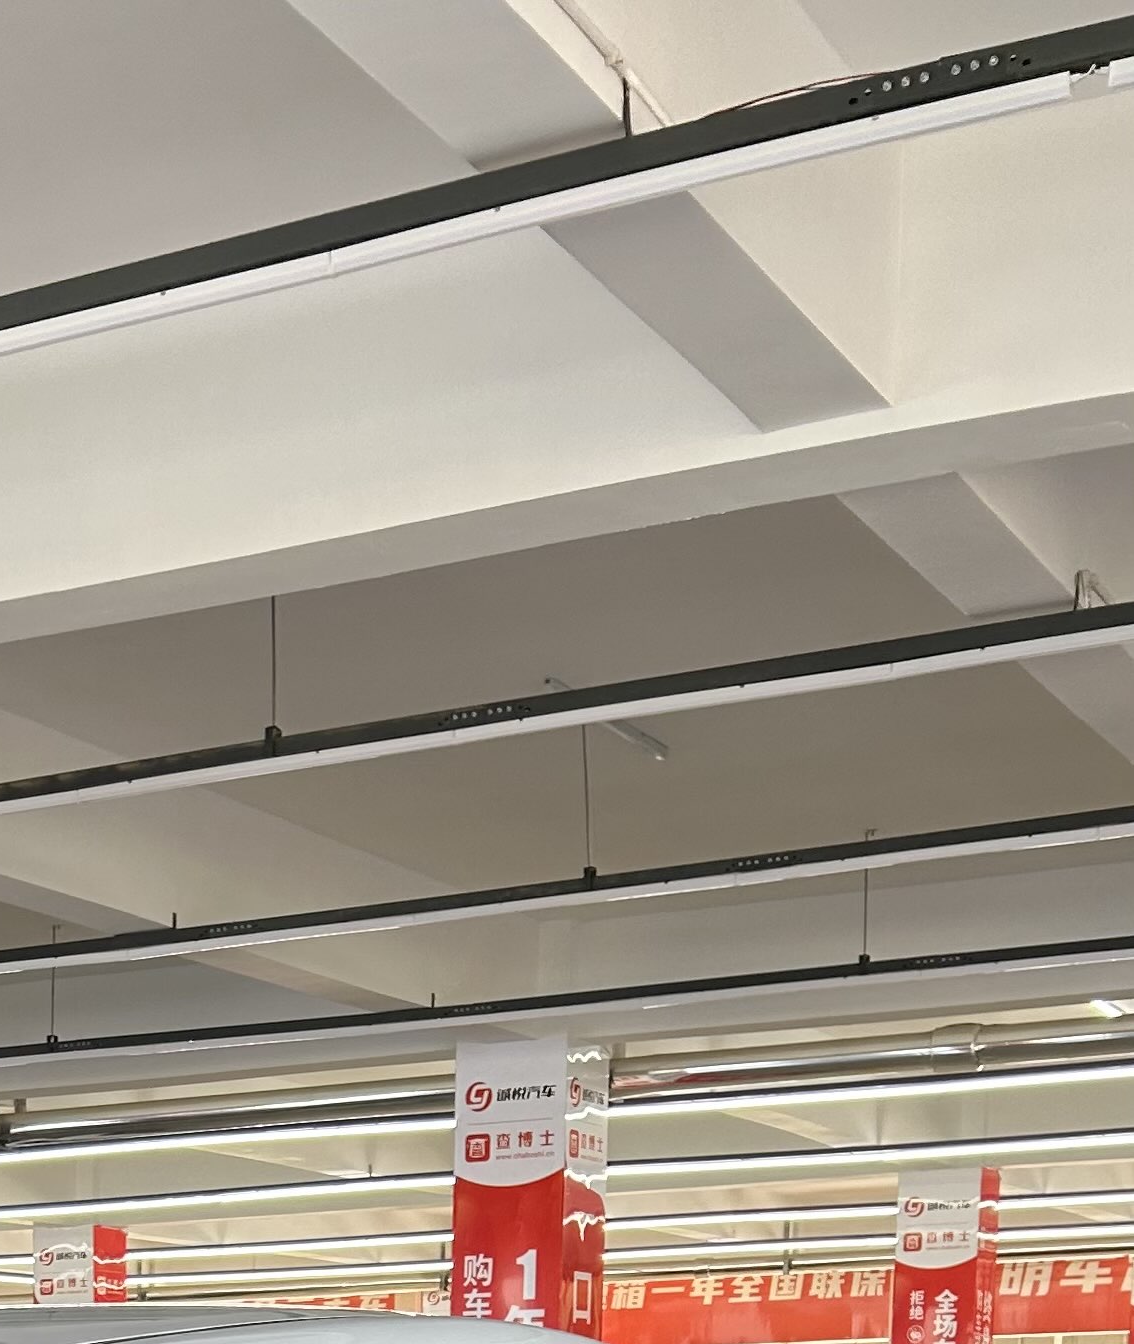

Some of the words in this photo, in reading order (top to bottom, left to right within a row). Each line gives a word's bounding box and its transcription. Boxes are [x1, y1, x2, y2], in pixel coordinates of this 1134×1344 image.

[462, 1253, 493, 1319] 购车
[602, 1270, 886, 1311] 箱一年全国联保
[998, 1259, 1134, 1307] 明车
